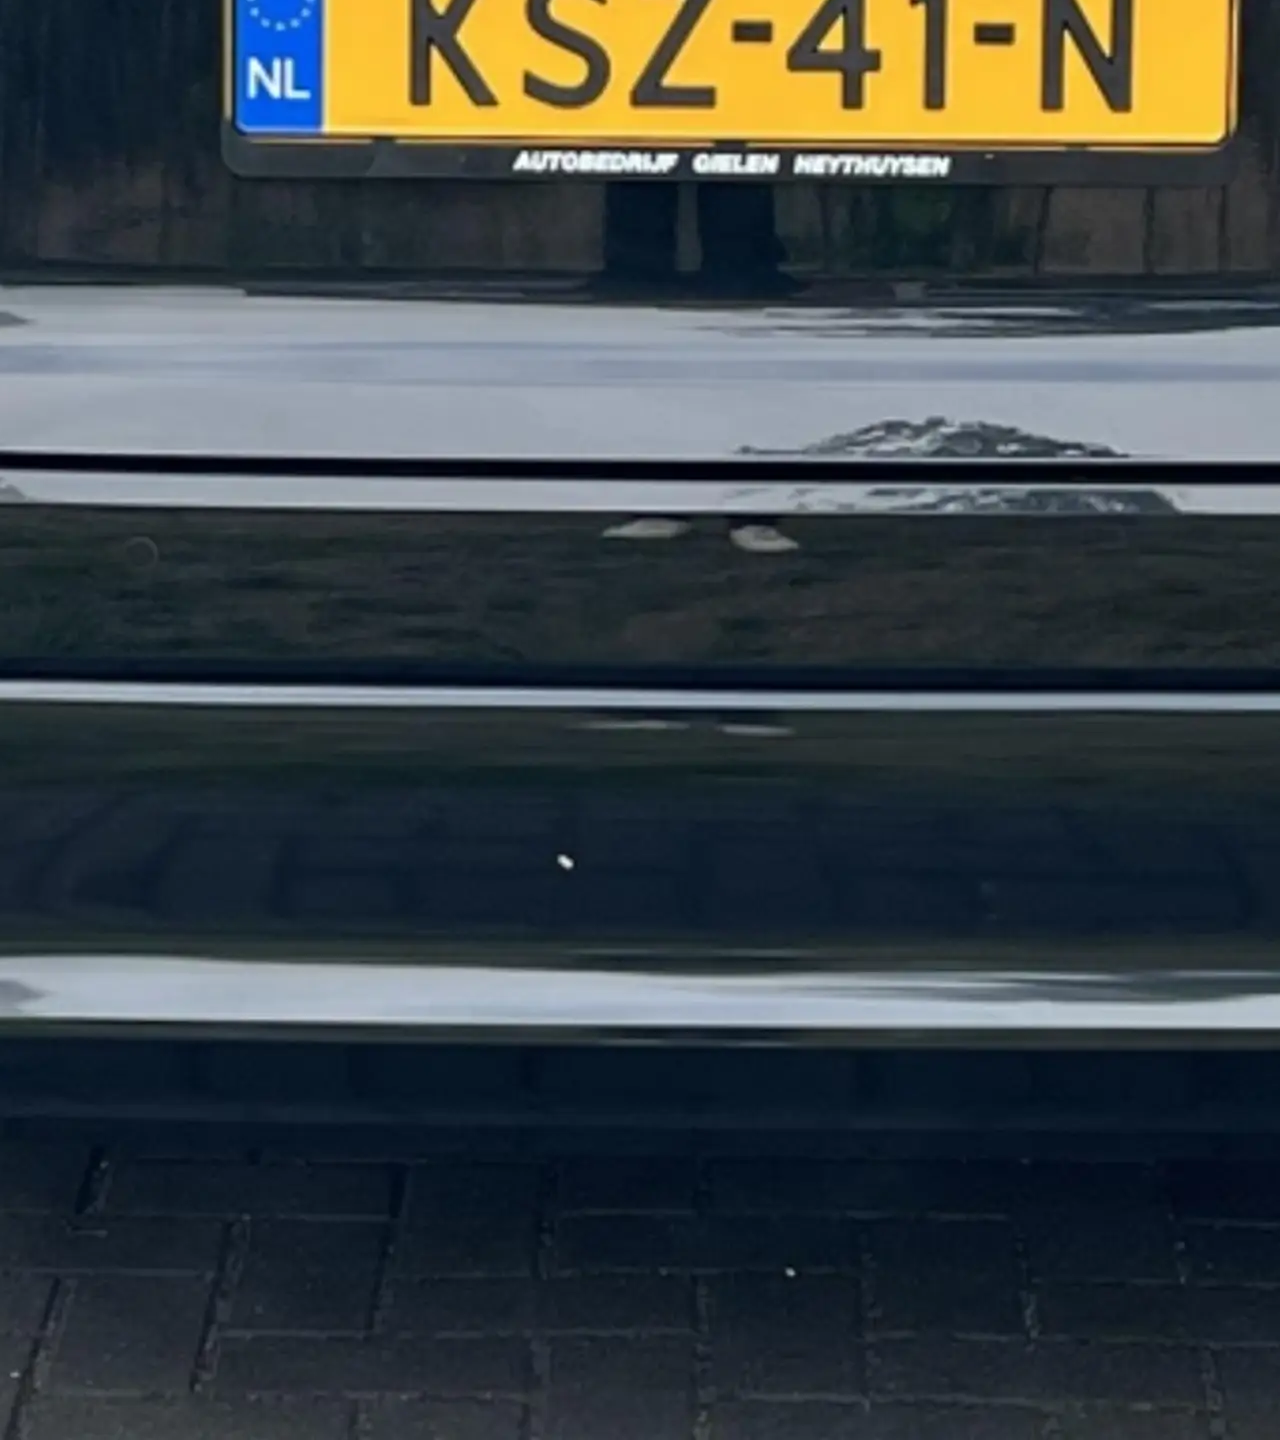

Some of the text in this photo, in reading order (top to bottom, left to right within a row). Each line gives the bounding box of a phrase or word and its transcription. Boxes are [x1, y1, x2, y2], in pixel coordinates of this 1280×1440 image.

[247, 58, 311, 100] NL
[513, 150, 950, 177] AUTOBEDRIJF GIELEN HEYTHUYSEN
